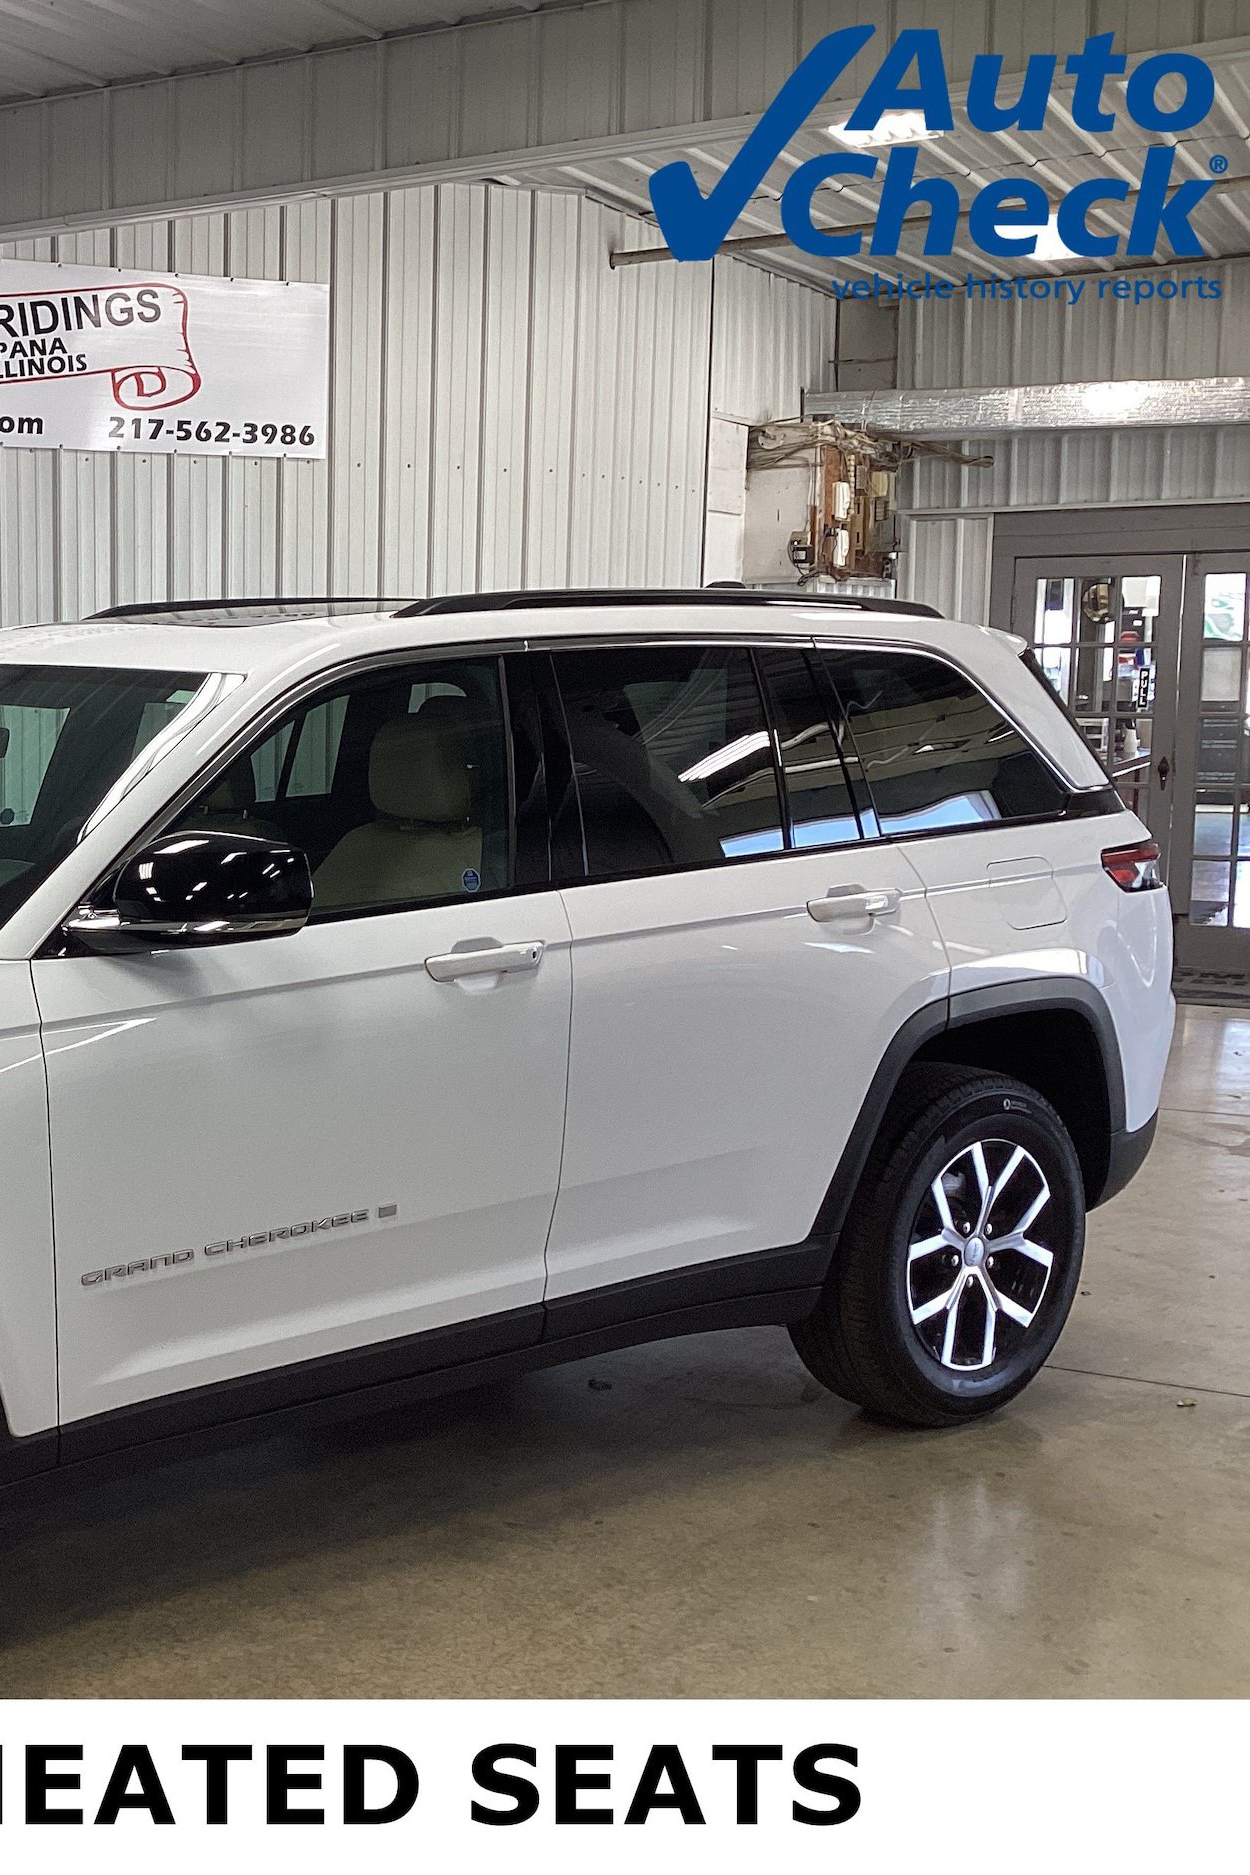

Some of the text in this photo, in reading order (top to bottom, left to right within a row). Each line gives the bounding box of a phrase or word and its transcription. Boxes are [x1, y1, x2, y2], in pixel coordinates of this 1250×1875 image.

[108, 416, 315, 446] 217-562-3986
[1139, 670, 1149, 706] PULL
[80, 1208, 370, 1287] GRAND CHEROKEE
